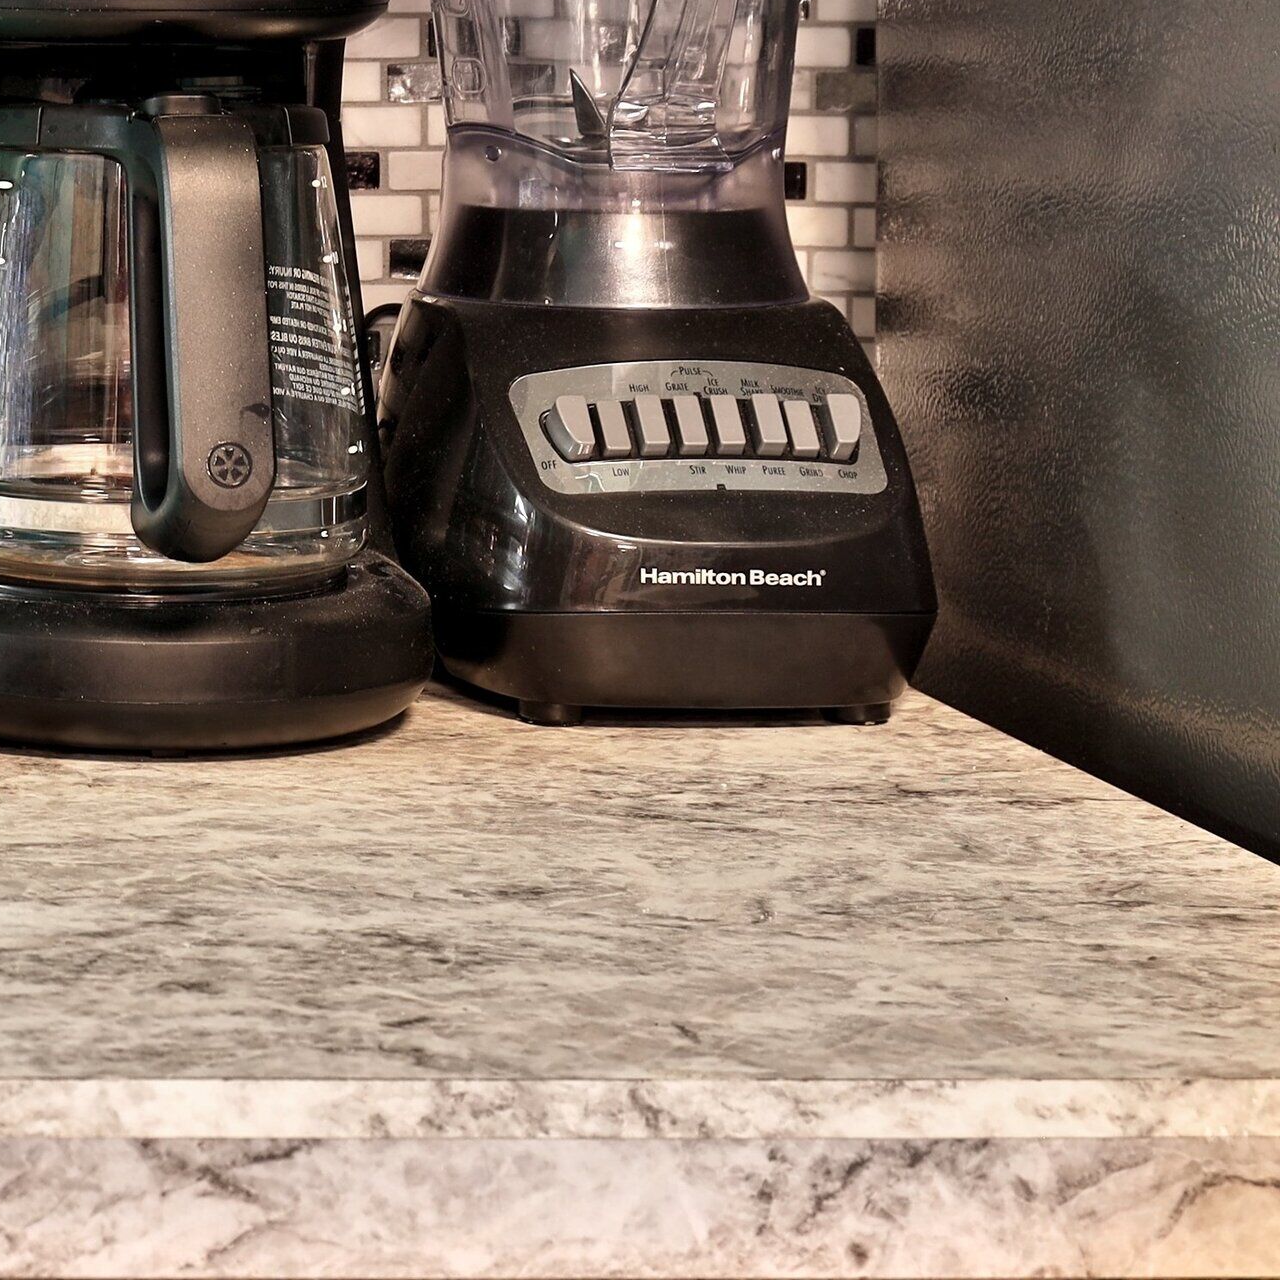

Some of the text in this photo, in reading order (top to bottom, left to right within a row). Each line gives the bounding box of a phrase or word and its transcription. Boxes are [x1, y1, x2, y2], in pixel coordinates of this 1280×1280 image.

[679, 366, 702, 375] PULSE
[665, 382, 689, 391] GRATE
[708, 378, 719, 386] ICE
[741, 379, 759, 388] MILK
[629, 384, 649, 392] HIGH
[704, 386, 728, 395] CRUSH
[771, 385, 804, 397] SMOOTHIE
[541, 460, 557, 470] OFF
[690, 465, 706, 475] STIR
[725, 465, 747, 475] WHIP
[612, 468, 629, 477] LOW
[762, 465, 786, 476] PUREE
[799, 466, 824, 477] GRIND
[838, 469, 857, 479] CHOP
[640, 568, 822, 586] Hamilton Beach
